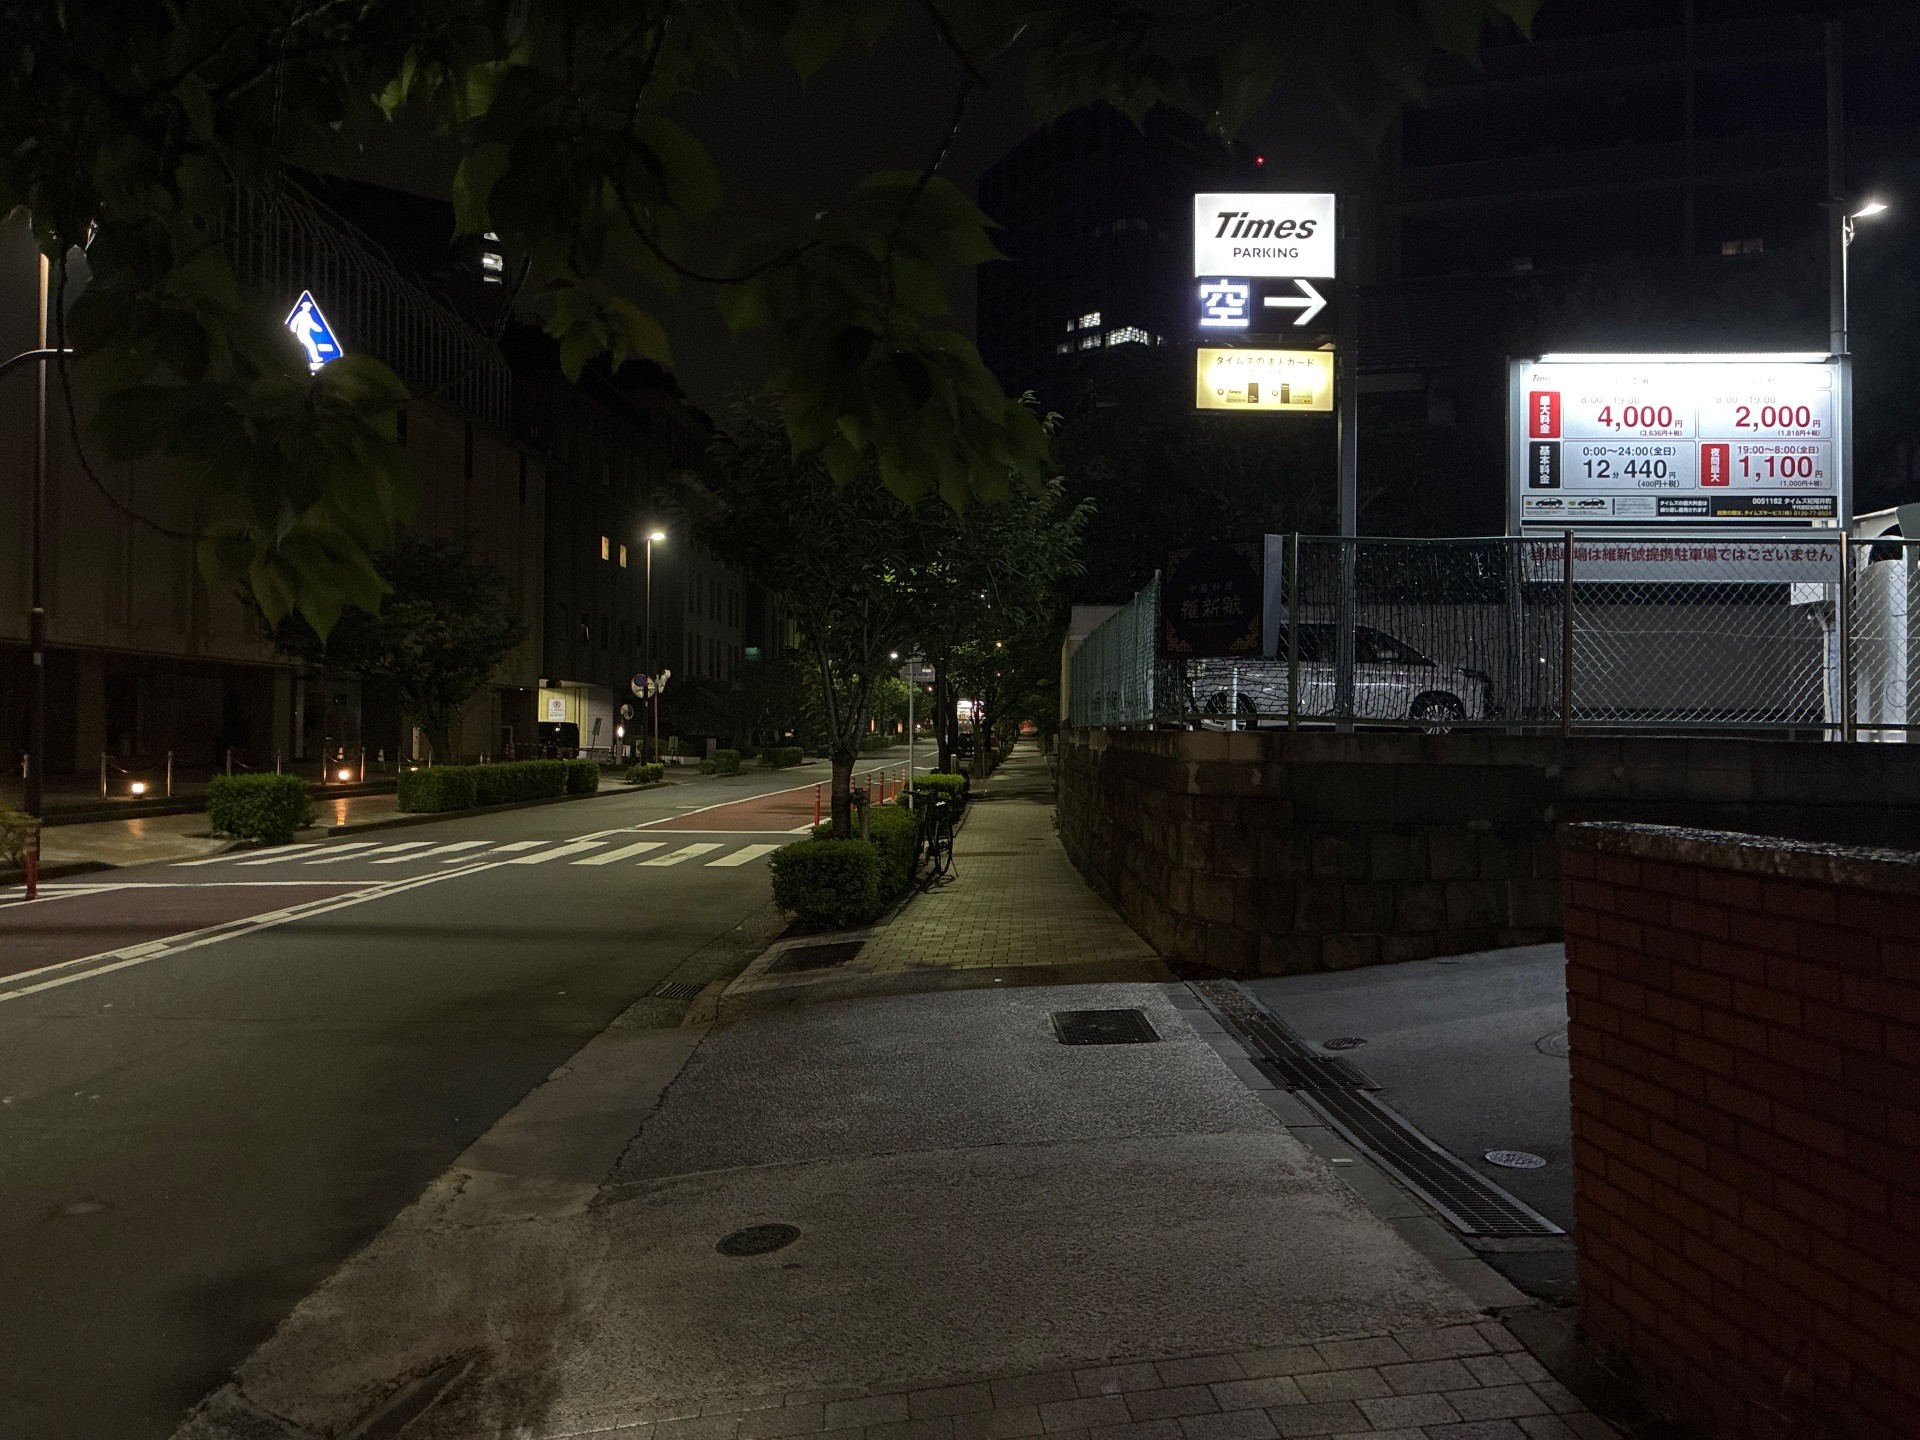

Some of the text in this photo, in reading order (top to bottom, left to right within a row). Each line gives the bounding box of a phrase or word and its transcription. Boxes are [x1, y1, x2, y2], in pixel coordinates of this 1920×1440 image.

[1215, 211, 1317, 239] Times
[1233, 247, 1299, 259] PARKING
[1199, 279, 1249, 326] 空
[1539, 445, 1550, 485] 基本料金
